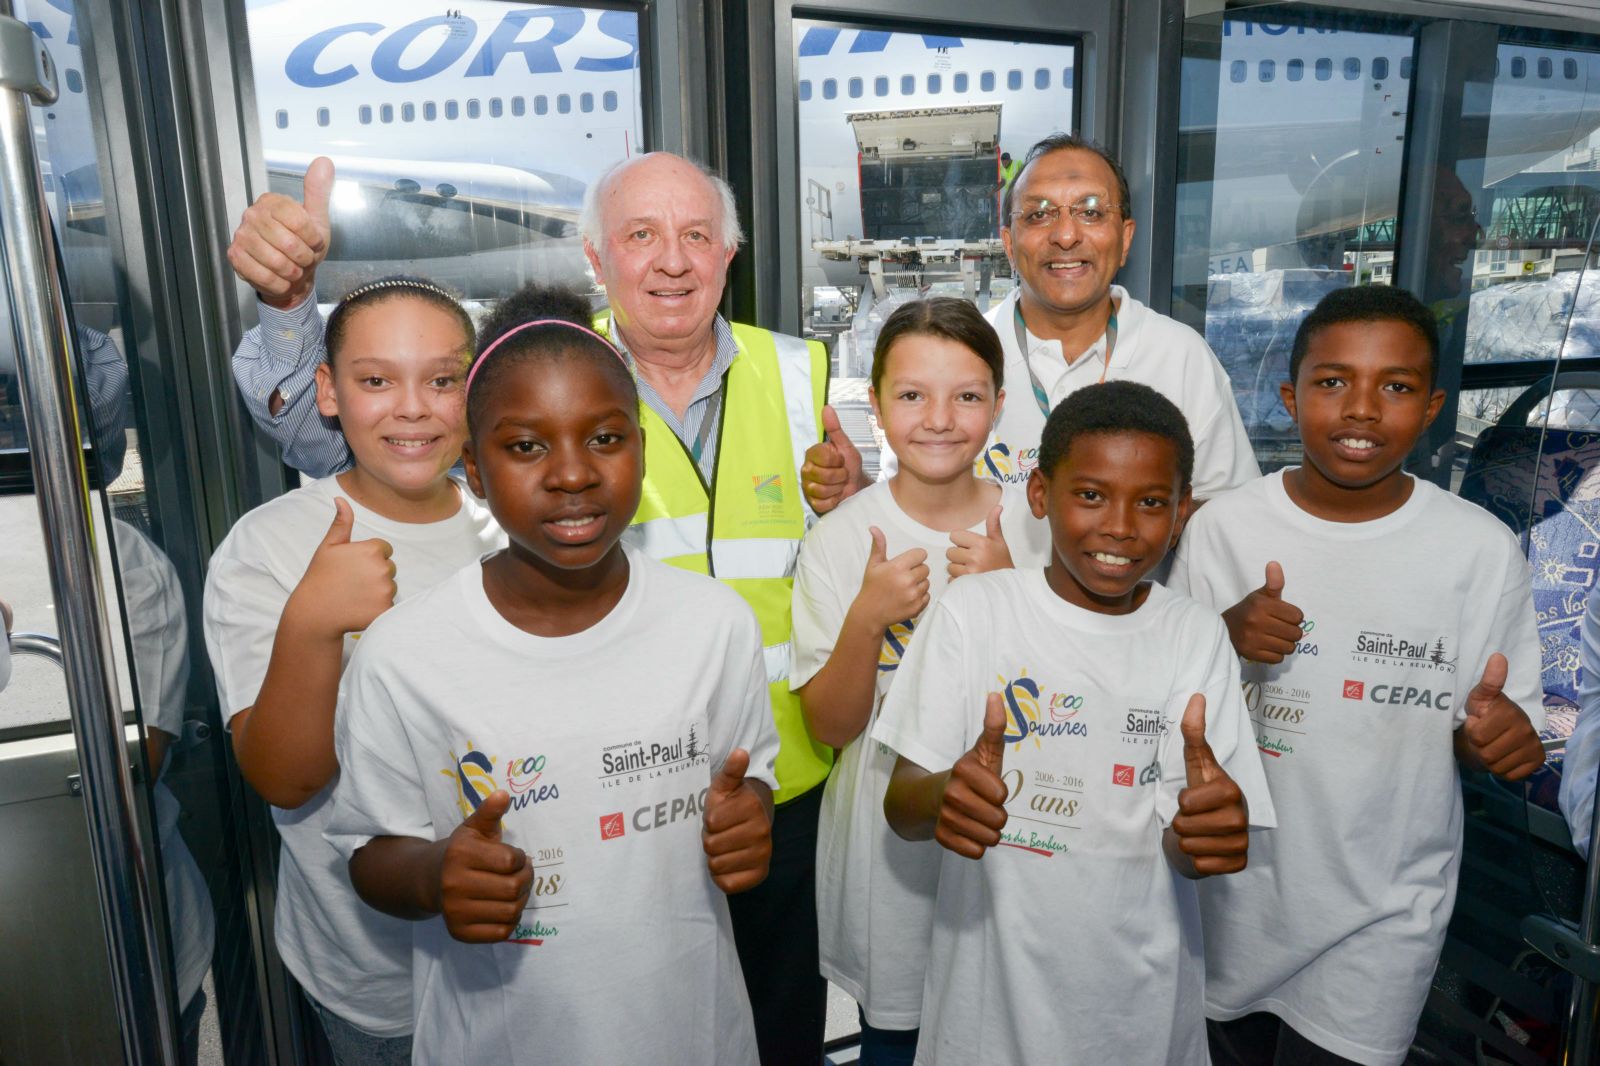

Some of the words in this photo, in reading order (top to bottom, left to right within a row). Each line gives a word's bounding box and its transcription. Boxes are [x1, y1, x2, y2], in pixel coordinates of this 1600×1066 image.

[1357, 635, 1427, 659] Saint-Paul
[1265, 684, 1284, 695] 2006
[1291, 687, 1311, 699] 2016
[1370, 685, 1453, 711] CEPAC
[1263, 703, 1305, 724] ans
[602, 737, 682, 774] Saint-Paul
[602, 779, 620, 789] ILE
[629, 775, 642, 783] DE
[649, 770, 662, 779] LA
[1034, 770, 1055, 783] 2006
[1062, 775, 1084, 789] 2016
[1030, 793, 1080, 817] ans
[537, 847, 563, 861] 2016
